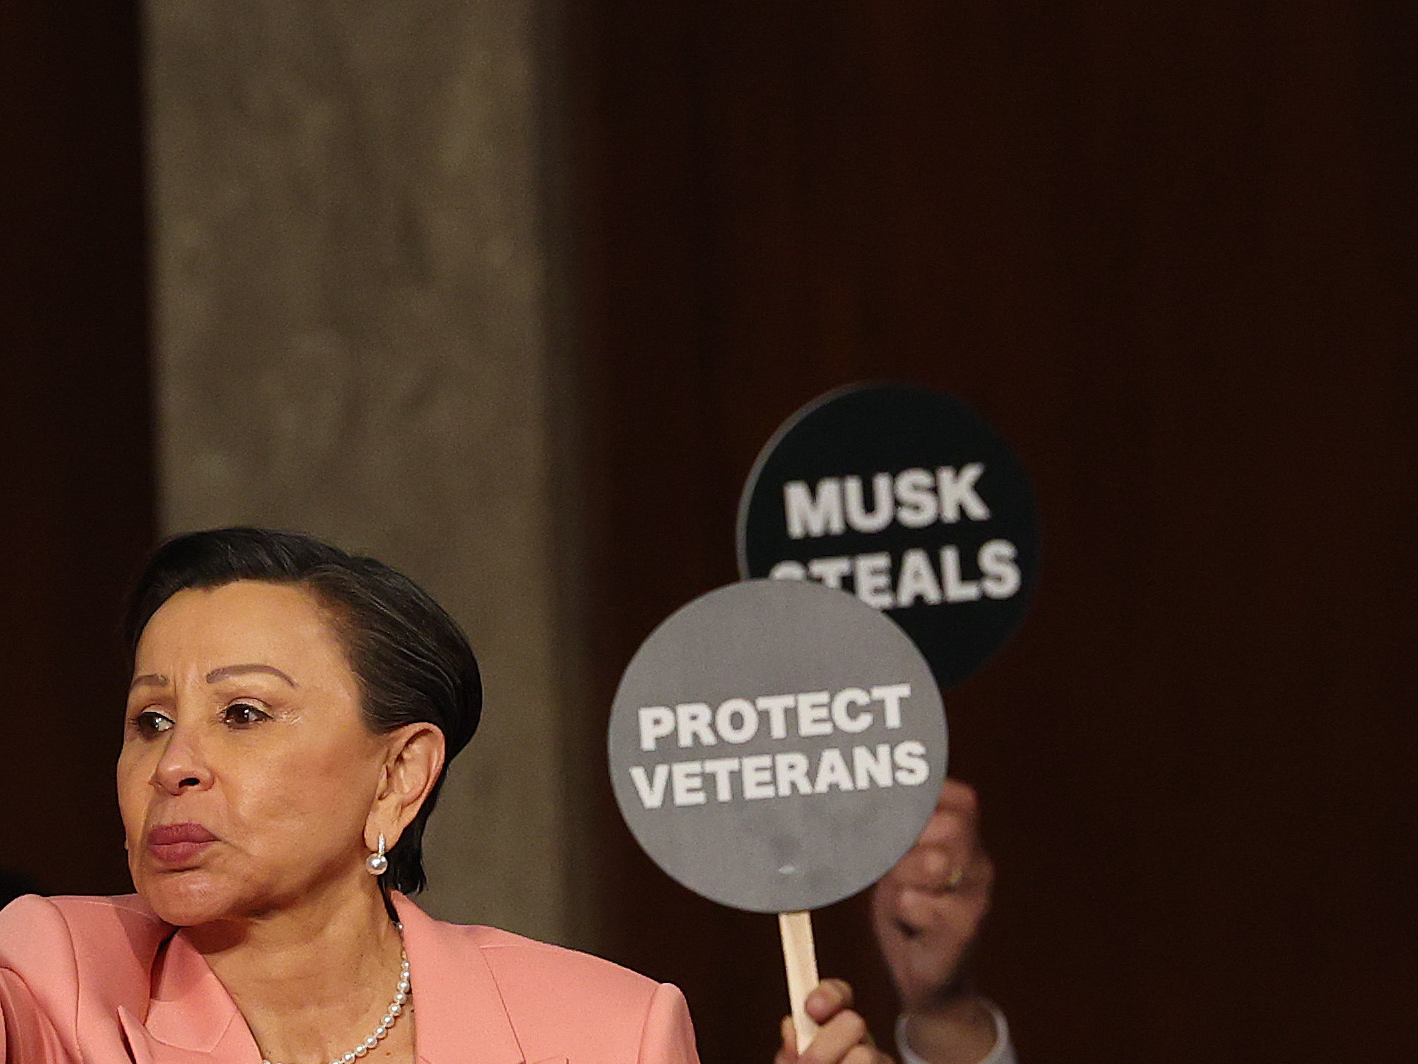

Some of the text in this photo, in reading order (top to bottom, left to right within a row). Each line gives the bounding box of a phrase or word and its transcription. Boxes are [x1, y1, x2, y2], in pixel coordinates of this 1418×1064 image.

[784, 463, 990, 540] MUSK
[637, 682, 912, 752] PROTECT
[628, 739, 930, 810] VETERANS
